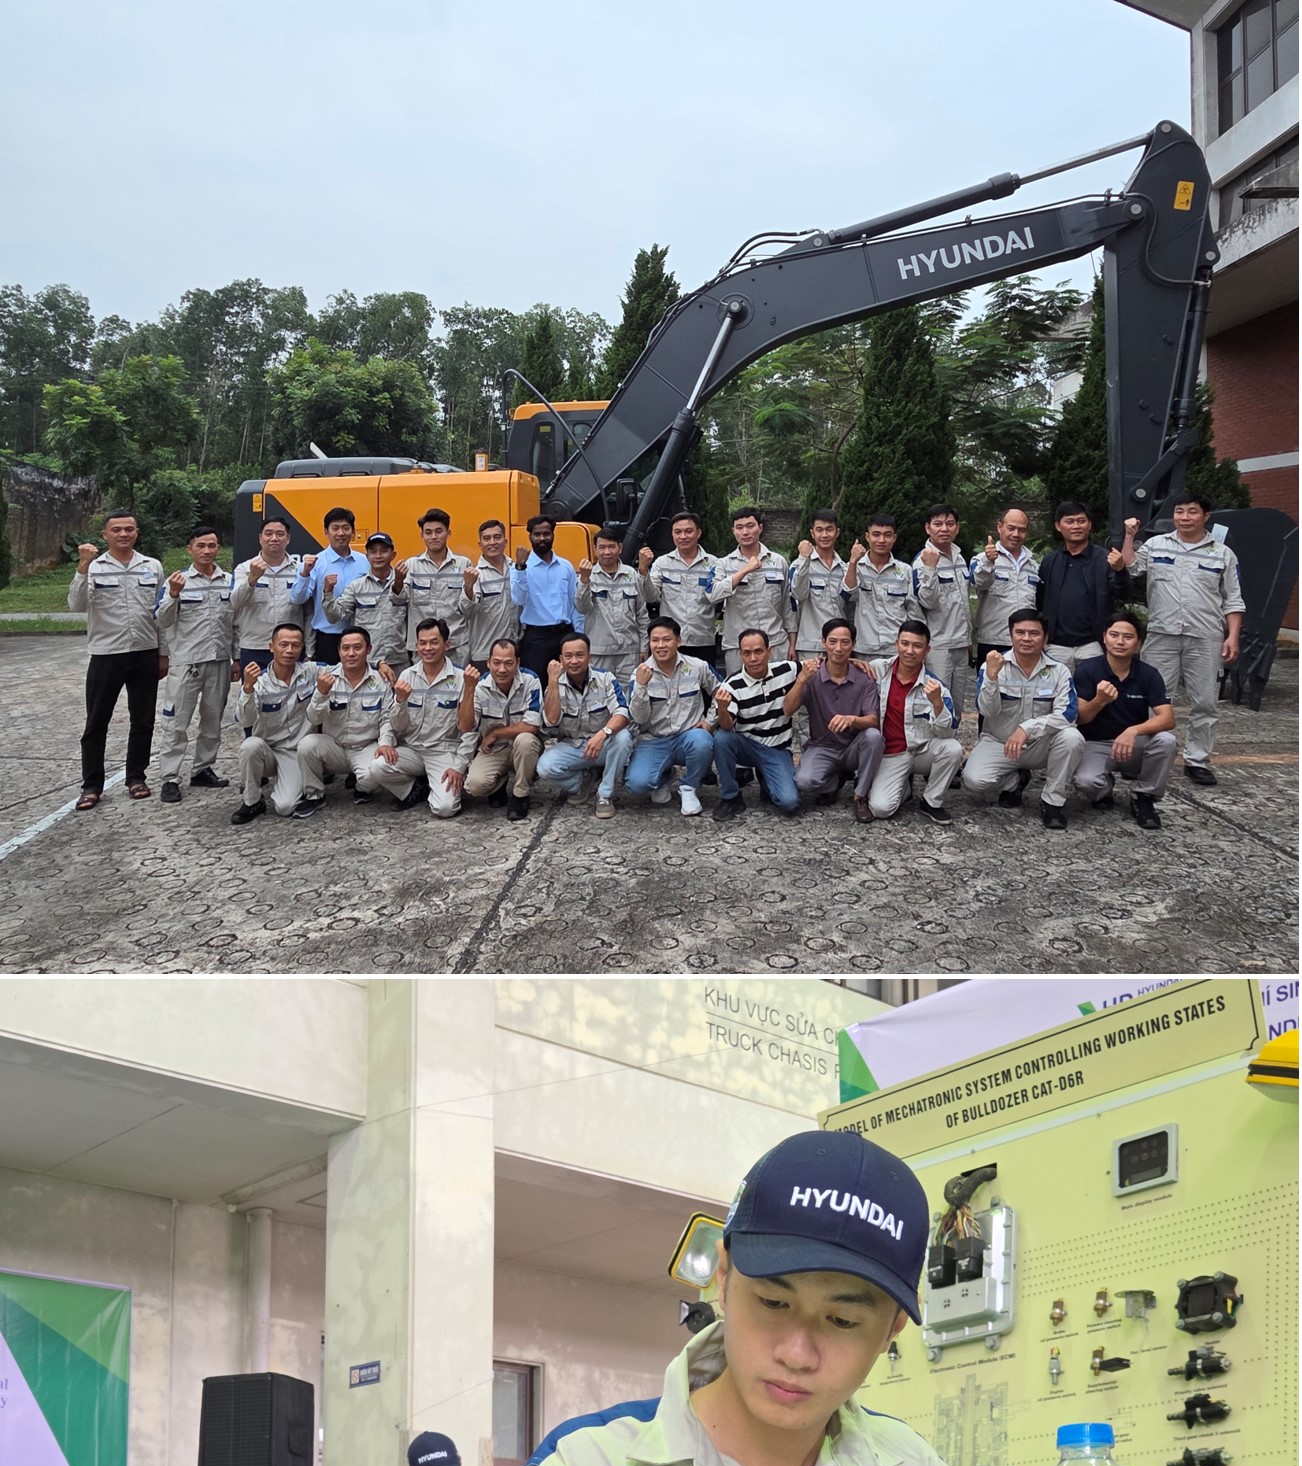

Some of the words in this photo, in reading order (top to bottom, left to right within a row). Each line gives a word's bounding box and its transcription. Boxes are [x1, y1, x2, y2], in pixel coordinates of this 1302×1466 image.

[897, 226, 1035, 280] HYUNDAI
[705, 986, 740, 1013] KHU
[745, 1000, 781, 1026] VỰC
[785, 1012, 818, 1041] SỬA
[705, 1021, 763, 1056] TRUCK
[768, 1042, 827, 1075] CHASIS
[870, 1113, 883, 1129] OF
[885, 1087, 963, 1124] MECHATRONIC
[966, 1068, 1012, 1097] SYSTEM
[1015, 1038, 1101, 1080] CONTROLLING
[1104, 1014, 1171, 1049] WORKING
[1173, 995, 1226, 1026] STATES
[946, 1114, 960, 1129] OF
[963, 1087, 1029, 1123] BULLDOZER
[1031, 1070, 1084, 1099] CAT-D6R
[790, 1186, 904, 1241] HYUNDAI
[417, 1450, 448, 1464] HYUNDAI
